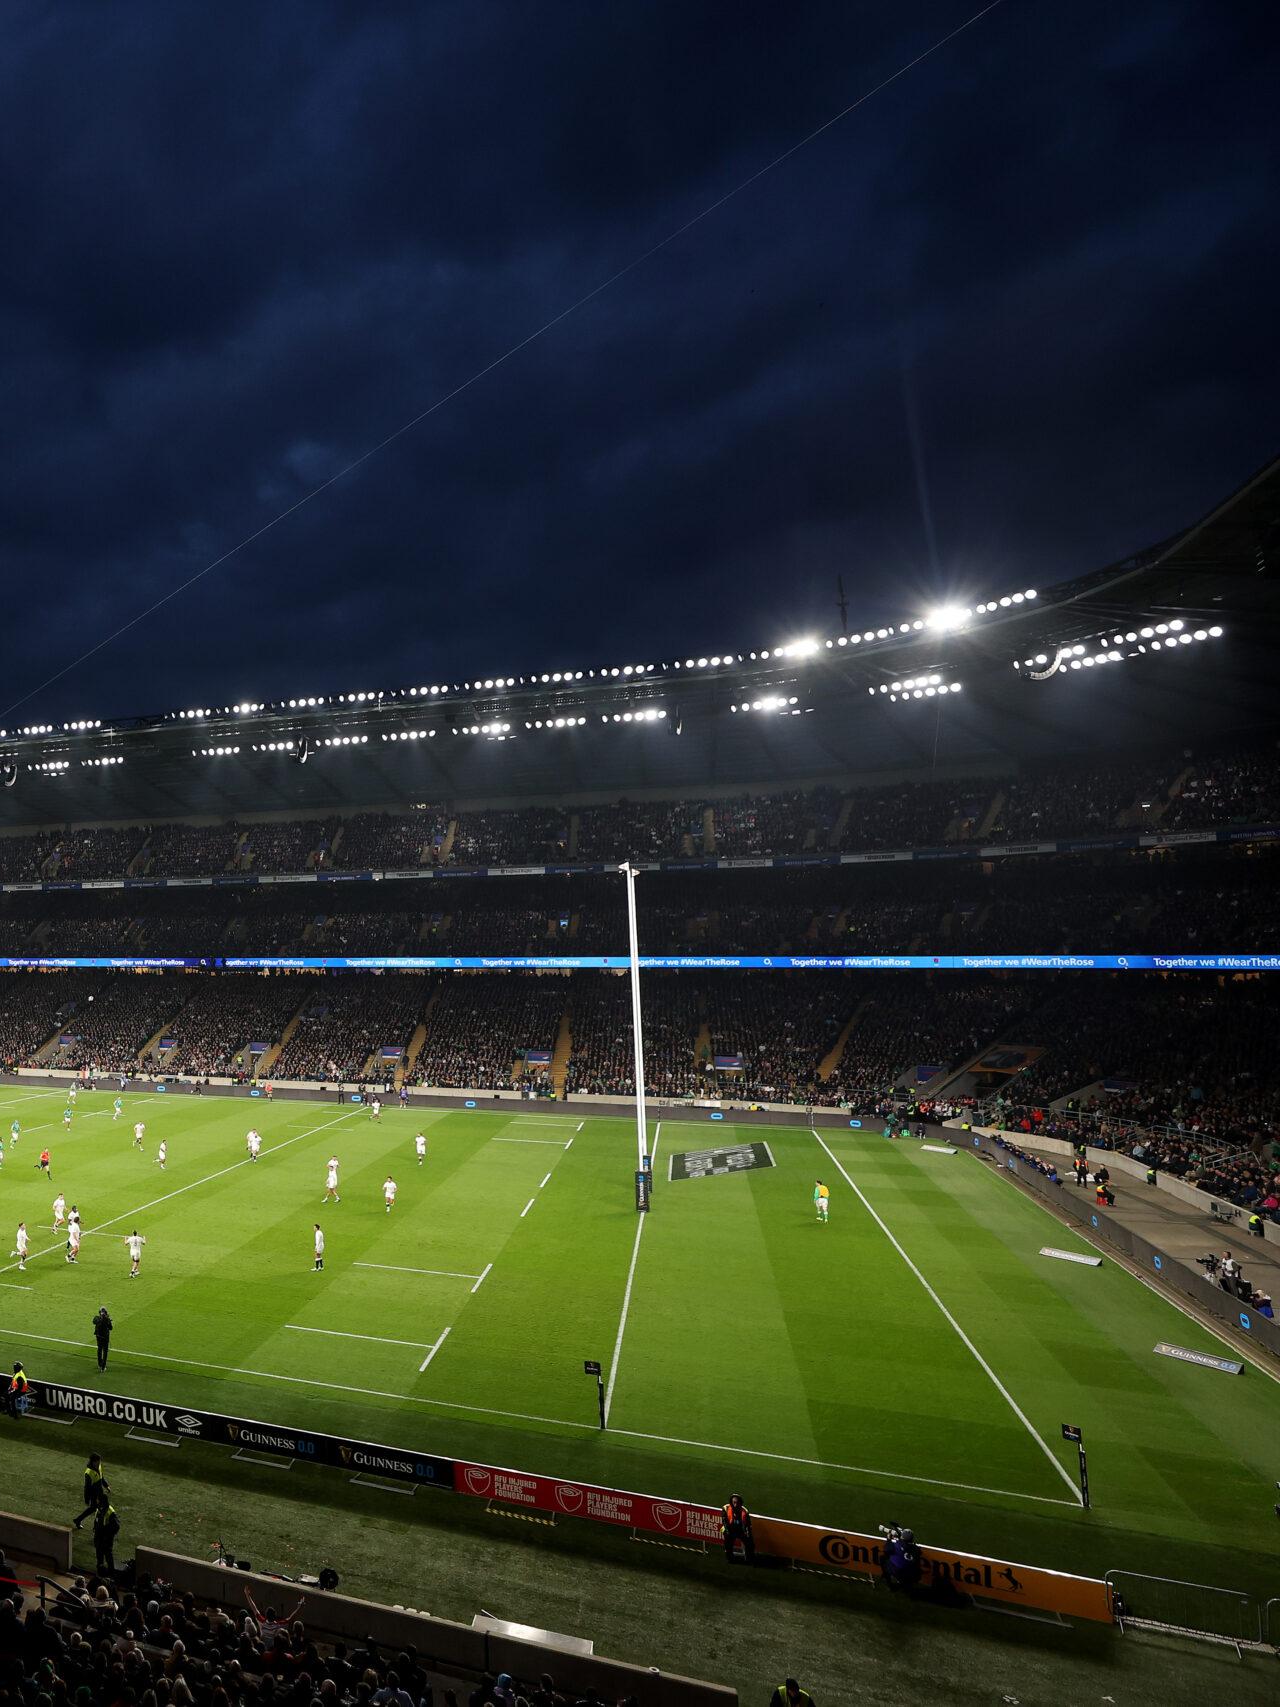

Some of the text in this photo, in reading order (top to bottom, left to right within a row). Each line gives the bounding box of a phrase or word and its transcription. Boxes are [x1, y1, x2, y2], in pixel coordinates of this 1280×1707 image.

[8, 959, 30, 967] Together
[111, 958, 134, 967] Together
[144, 958, 185, 966] #WearTheRose
[225, 958, 248, 967] ogether
[260, 958, 305, 966] #WearTheRose
[346, 958, 374, 967] Together
[386, 958, 436, 966] #WearTheRose
[482, 958, 513, 967] Together
[526, 958, 581, 966] #WearTheRose
[791, 958, 911, 968] Together we #WearTheRose
[962, 957, 1094, 968] Together we #WearTheRose
[1153, 957, 1197, 969] Together
[1199, 958, 1216, 968] we
[1170, 1348, 1236, 1370] GUINNESS 0.0
[45, 1388, 167, 1428] UMBRO.CO.UK
[177, 1425, 201, 1436] umbro
[240, 1429, 315, 1454] GUINNESS 0.0
[353, 1451, 434, 1479] GUINNESS 0.0
[494, 1474, 537, 1490] RFU INJURED
[494, 1481, 523, 1494] PLAYERS
[494, 1488, 535, 1503] FOUNDATION
[587, 1491, 633, 1508] RFU INJURED
[587, 1498, 618, 1513] PLAYERS
[587, 1506, 631, 1522] FOUNDATION
[686, 1510, 723, 1525] RFU INJU
[686, 1518, 719, 1531] PLAYERS
[686, 1526, 725, 1541] FOUNDATI
[818, 1534, 993, 1589] Contental
